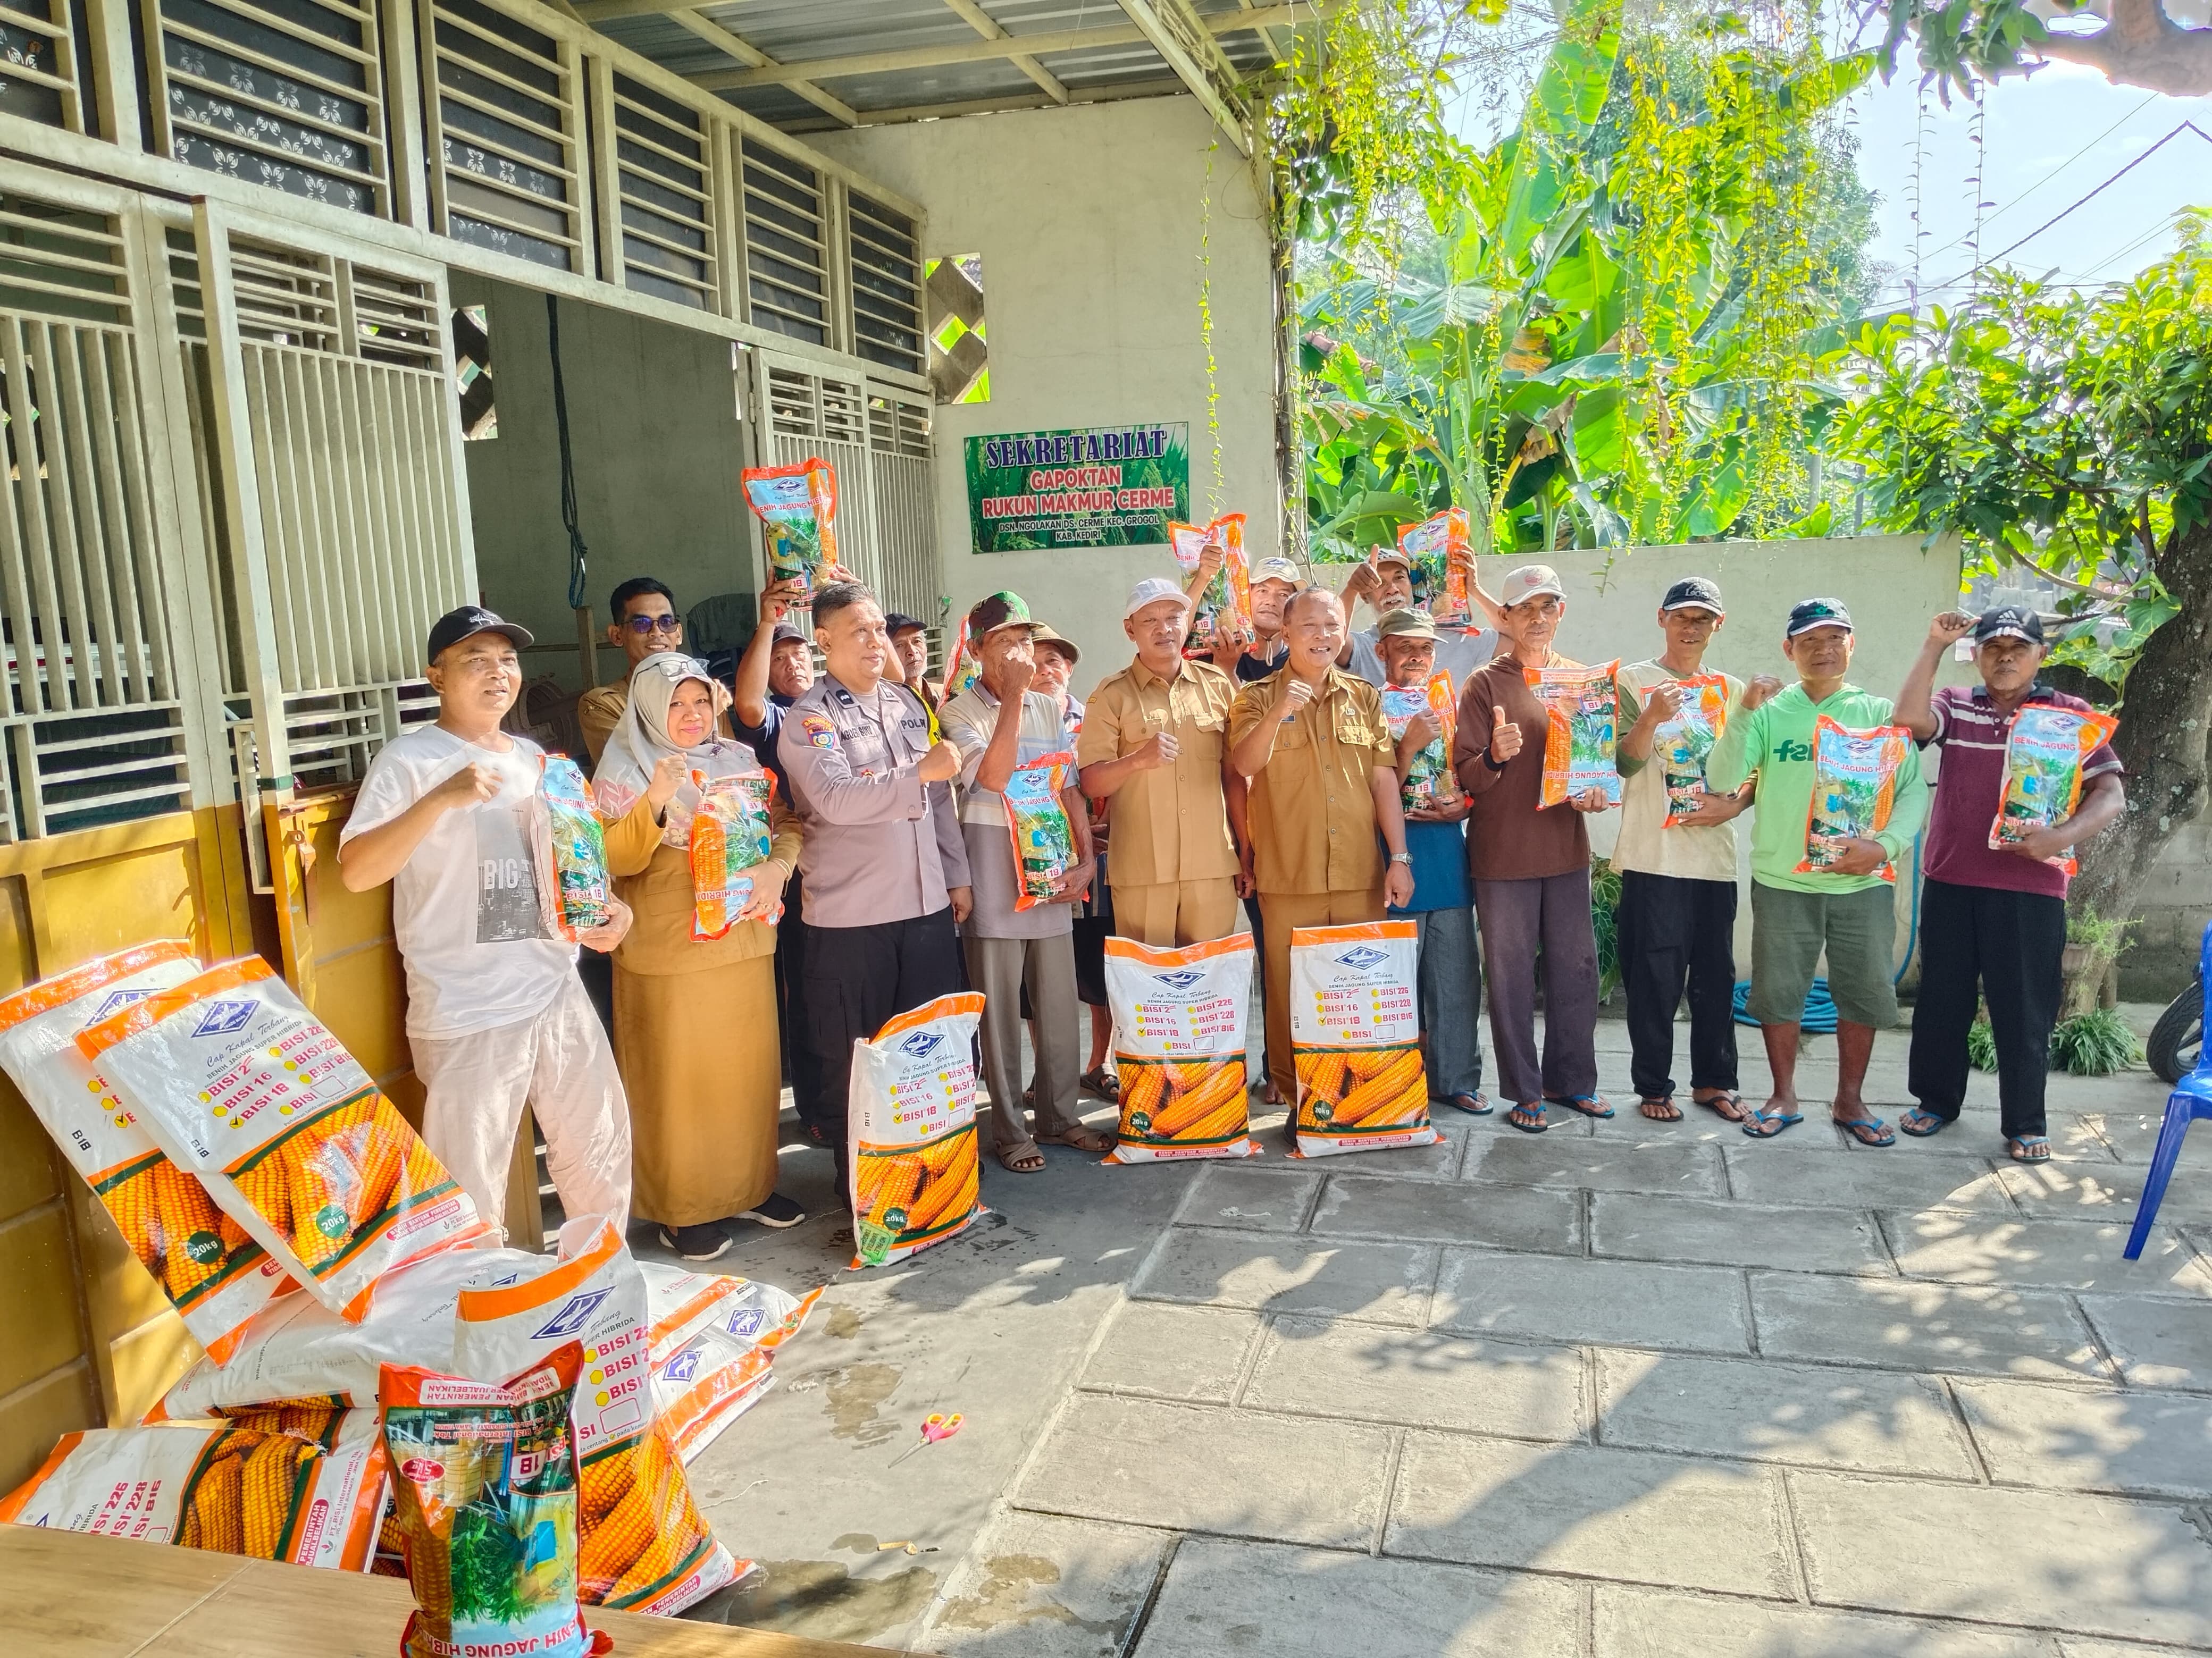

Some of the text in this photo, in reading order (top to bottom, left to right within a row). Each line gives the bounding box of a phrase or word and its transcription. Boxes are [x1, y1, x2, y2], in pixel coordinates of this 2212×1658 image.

[986, 430, 1167, 468] SEKRETARIAT
[1031, 467, 1121, 490] GAPOKTAN
[983, 488, 1174, 518] RUKUN MAKMUR CERME
[1019, 520, 1061, 532] NGOLAKAN
[1078, 518, 1104, 527] CERME
[1107, 517, 1125, 526] KEC.
[1126, 515, 1158, 525] GROGOL
[1055, 531, 1101, 541] KAB. KEDIRI
[2014, 737, 2076, 751] BENIH JAGUNG
[1026, 797, 1050, 805] JAGUNG
[484, 858, 519, 889] BIG
[1196, 1002, 1215, 1012] BISI
[1381, 1000, 1397, 1009] BISI
[1199, 1013, 1218, 1023] BISI
[1201, 1025, 1219, 1034] BISI
[207, 1053, 224, 1067] Cap
[225, 1032, 255, 1053] Kapal
[280, 1032, 309, 1051] BISI
[206, 1064, 228, 1080] BENIH
[229, 1047, 255, 1065] JAGUNG
[255, 1037, 277, 1050] SUPER
[294, 1044, 322, 1065] BISI
[308, 1060, 336, 1079] BISI
[910, 1071, 930, 1080] JAGUNG
[931, 1064, 948, 1073] SUPER
[912, 1061, 932, 1072] Kapal
[948, 1068, 966, 1079] BISI
[207, 1064, 251, 1097] BISI 2
[897, 1085, 913, 1094] BISI
[953, 1081, 969, 1093] BISI
[223, 1072, 272, 1109] BISI 16
[240, 1082, 290, 1120] BISI 18
[290, 1092, 319, 1110] BISI
[899, 1097, 920, 1107] BISI
[956, 1096, 969, 1107] BISI
[903, 1106, 937, 1122] BISI 18
[1314, 1106, 1330, 1116] 20kg
[929, 1120, 946, 1132] BISI
[1132, 1117, 1148, 1126] 20kg
[320, 1214, 346, 1233] 20kg
[885, 1214, 904, 1223] 20kg
[192, 1241, 220, 1260] 20kg
[601, 1317, 635, 1336] HIBRIDA
[598, 1333, 631, 1357] BISI
[604, 1353, 638, 1378] BISI
[609, 1376, 643, 1400] BISI
[586, 1427, 631, 1450] centang pada
[519, 1454, 540, 1475] 18
[78, 1503, 99, 1531] IBRIDA
[89, 1482, 129, 1534] ISI 226
[109, 1481, 148, 1536] ISI 228
[130, 1479, 162, 1537] ISI 816
[299, 1504, 321, 1562] PEMERINTAH
[656, 1577, 698, 1607] PEMERINTAH
[466, 1638, 539, 1657] JAGUNG
